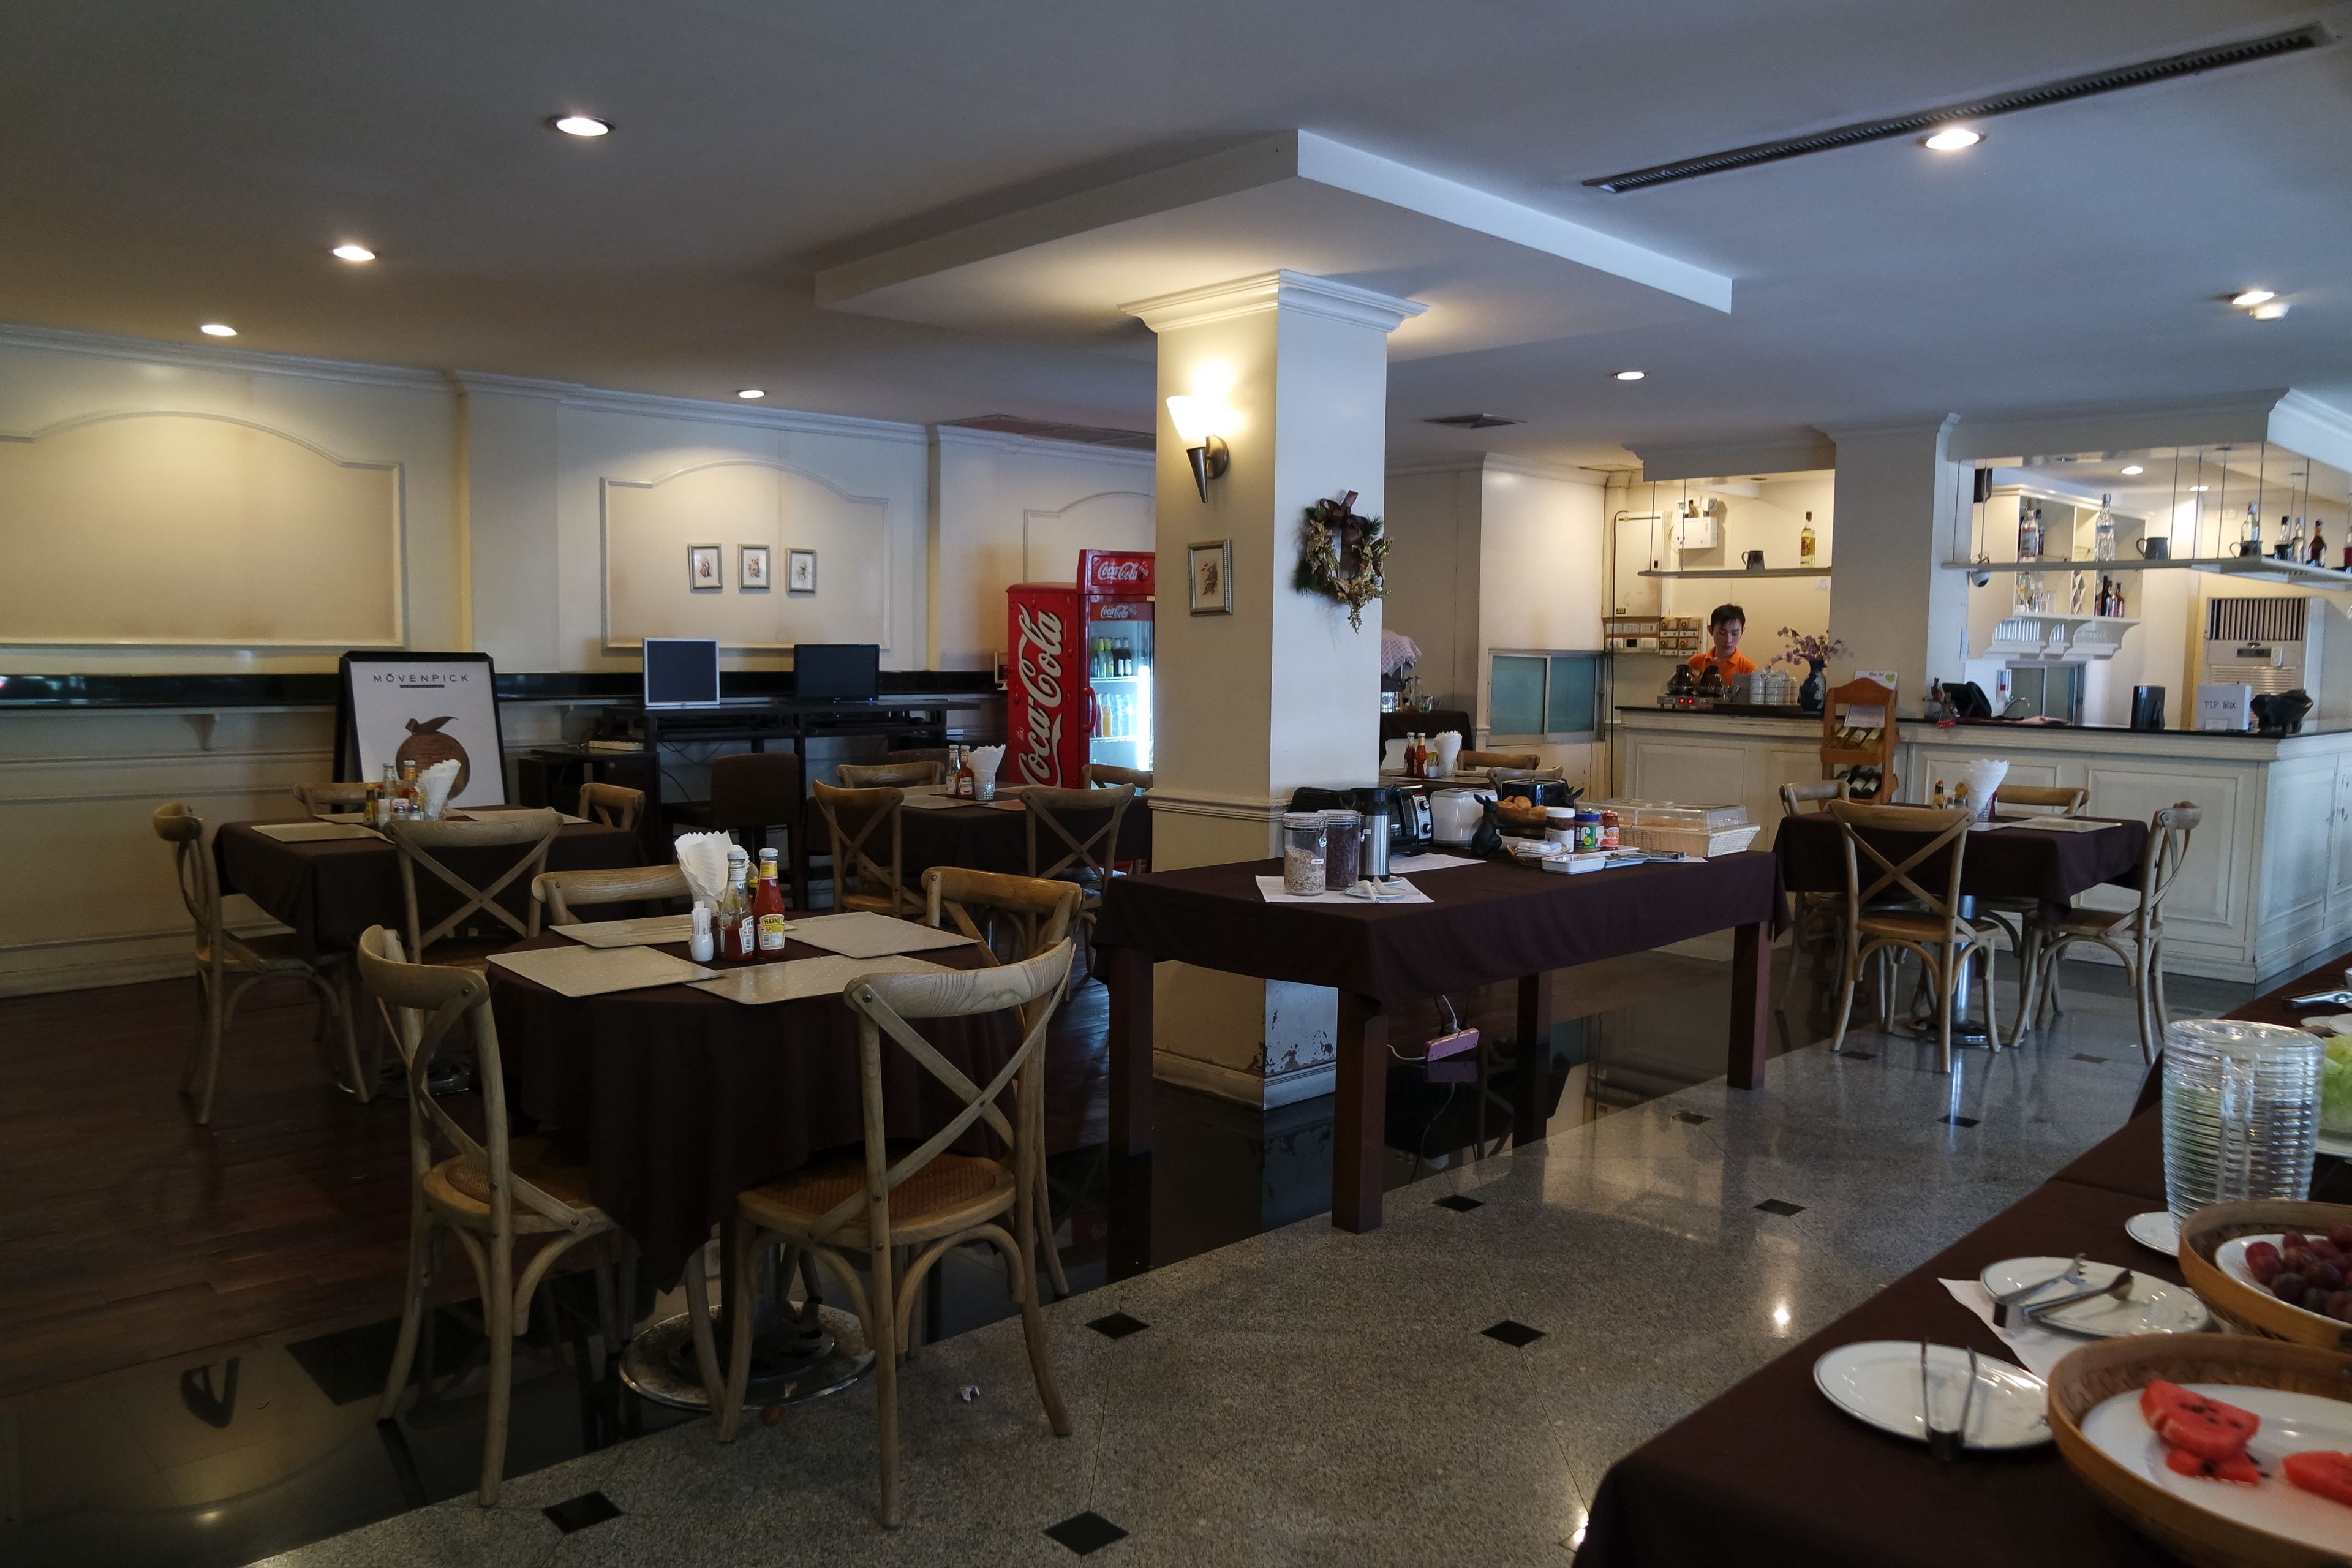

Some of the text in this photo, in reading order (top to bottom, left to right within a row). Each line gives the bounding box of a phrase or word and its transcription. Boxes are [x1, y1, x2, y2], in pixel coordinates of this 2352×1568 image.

[373, 673, 469, 682] MÖVENPICK
[2204, 701, 2236, 710] TIP BOX
[1575, 826, 1591, 841] if
